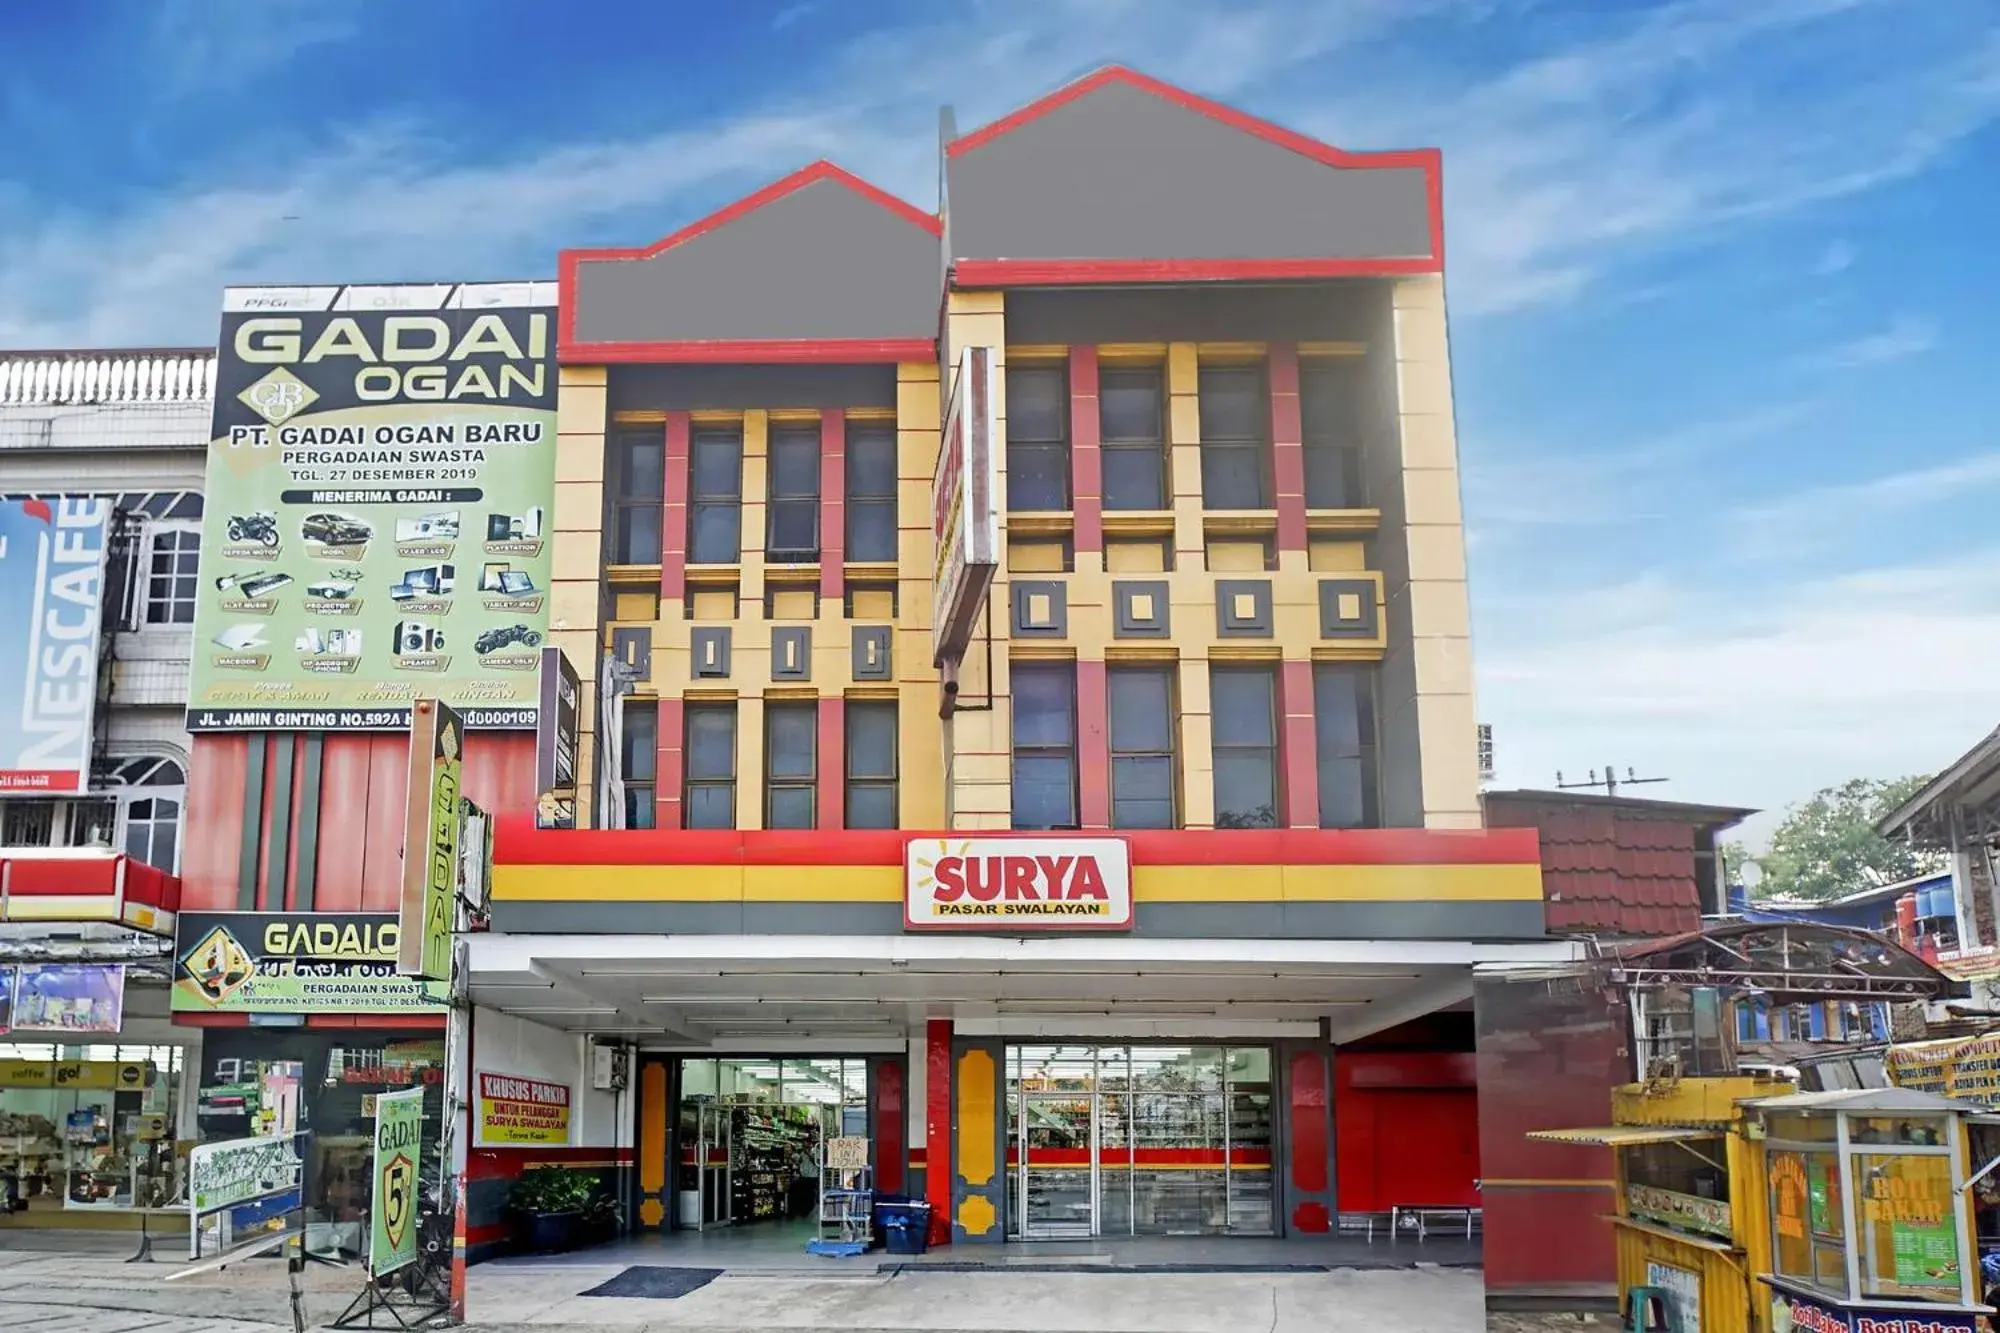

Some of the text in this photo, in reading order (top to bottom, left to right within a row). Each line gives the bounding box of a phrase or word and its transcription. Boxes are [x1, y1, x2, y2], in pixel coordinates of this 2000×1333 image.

[234, 314, 547, 364] GADAI
[355, 364, 545, 400] OGAN
[231, 424, 541, 445] PT. GADAI OGAN BARU
[283, 450, 485, 463] PERGADAIAN SWASTA
[291, 469, 477, 481] TGL. 27 DESEMBER 2019
[312, 490, 393, 502] MENERIMA
[396, 490, 443, 502] GADAI
[199, 713, 221, 726] JL.
[224, 713, 272, 726] JAMIN
[275, 713, 336, 726] GINTING
[933, 856, 1109, 902] SURYA
[939, 904, 1100, 914] PASAR SWALAYAN
[264, 923, 371, 954] GADAI
[302, 984, 427, 994] PERGADAIAN SWAST
[485, 1076, 566, 1104] KHUSUS PARKIR
[485, 1115, 567, 1129] SURYA SWALAYAN
[379, 1118, 421, 1151] GADAI
[1790, 1299, 1848, 1333] Roti Bakar
[1858, 1317, 1970, 1333] Roti Bakar
